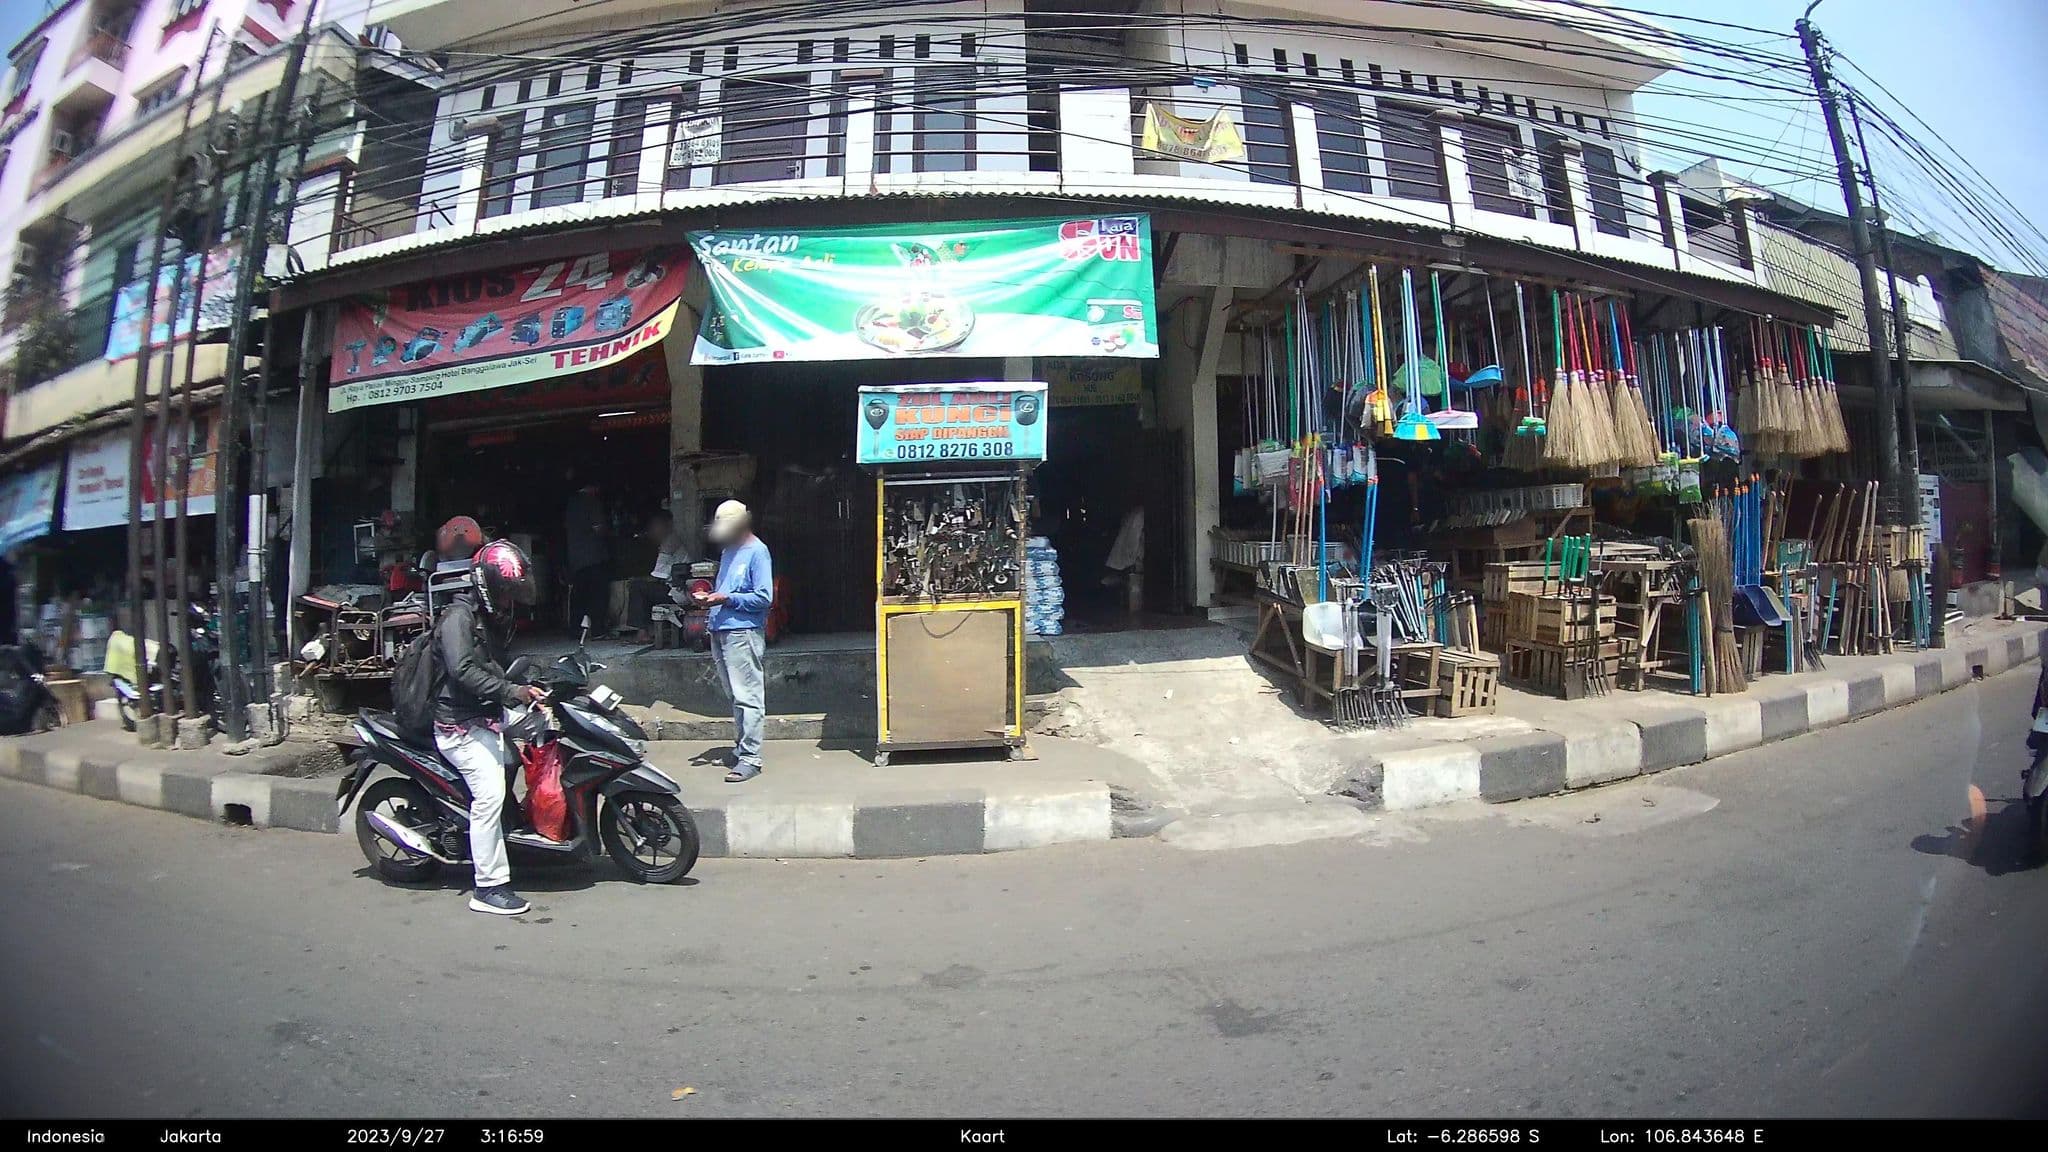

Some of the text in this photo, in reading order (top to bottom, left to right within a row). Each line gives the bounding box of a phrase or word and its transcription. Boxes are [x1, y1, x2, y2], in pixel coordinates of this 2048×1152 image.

[699, 233, 799, 257] Santan
[550, 321, 664, 370] TEHNIK
[368, 386, 391, 400] 0812
[393, 384, 416, 397] 9703
[420, 381, 443, 393] 7504
[895, 405, 1012, 425] KUNCI
[895, 428, 929, 441] SIAP
[897, 442, 1013, 459] 0812 8276 308
